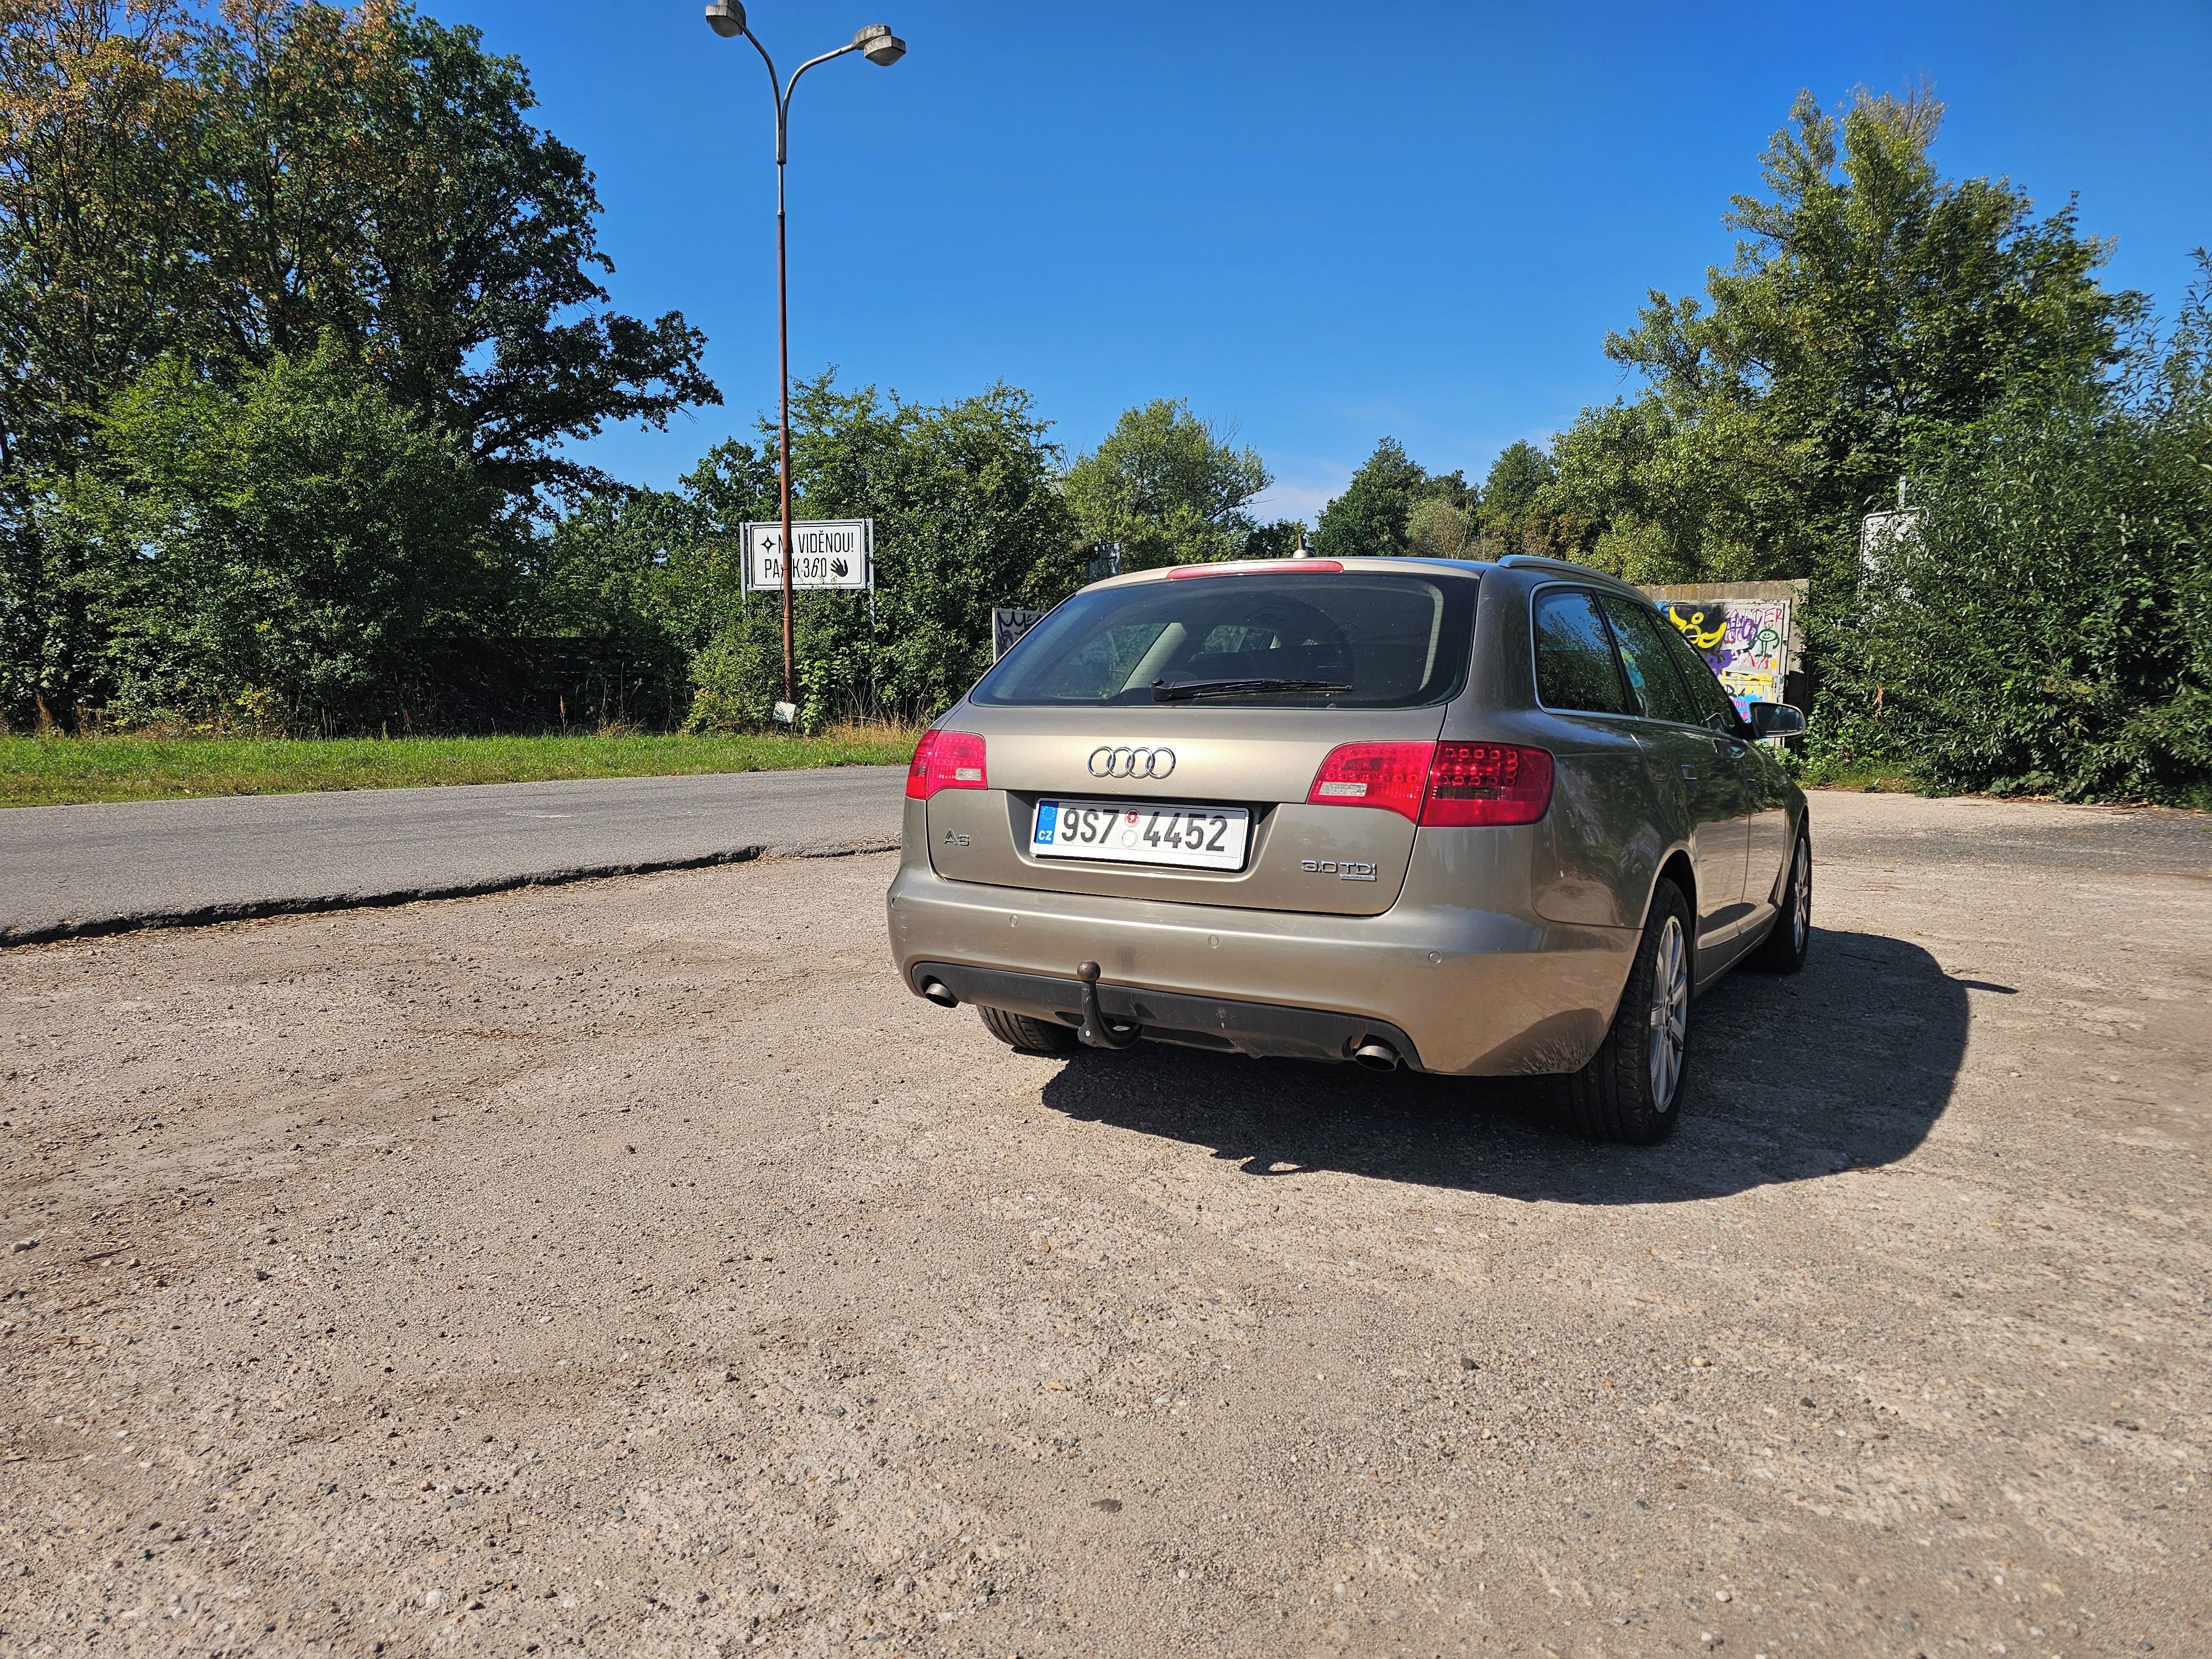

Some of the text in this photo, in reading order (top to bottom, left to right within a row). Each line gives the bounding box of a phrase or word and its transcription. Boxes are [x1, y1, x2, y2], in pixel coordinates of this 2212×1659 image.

[798, 530, 854, 554] VIDĚNOU!
[764, 558, 800, 578] PAK
[943, 828, 970, 847] A6
[1038, 830, 1052, 841] CZ
[1061, 808, 1228, 852] 9S7 4452
[1301, 859, 1378, 875] 3.0 TDI
